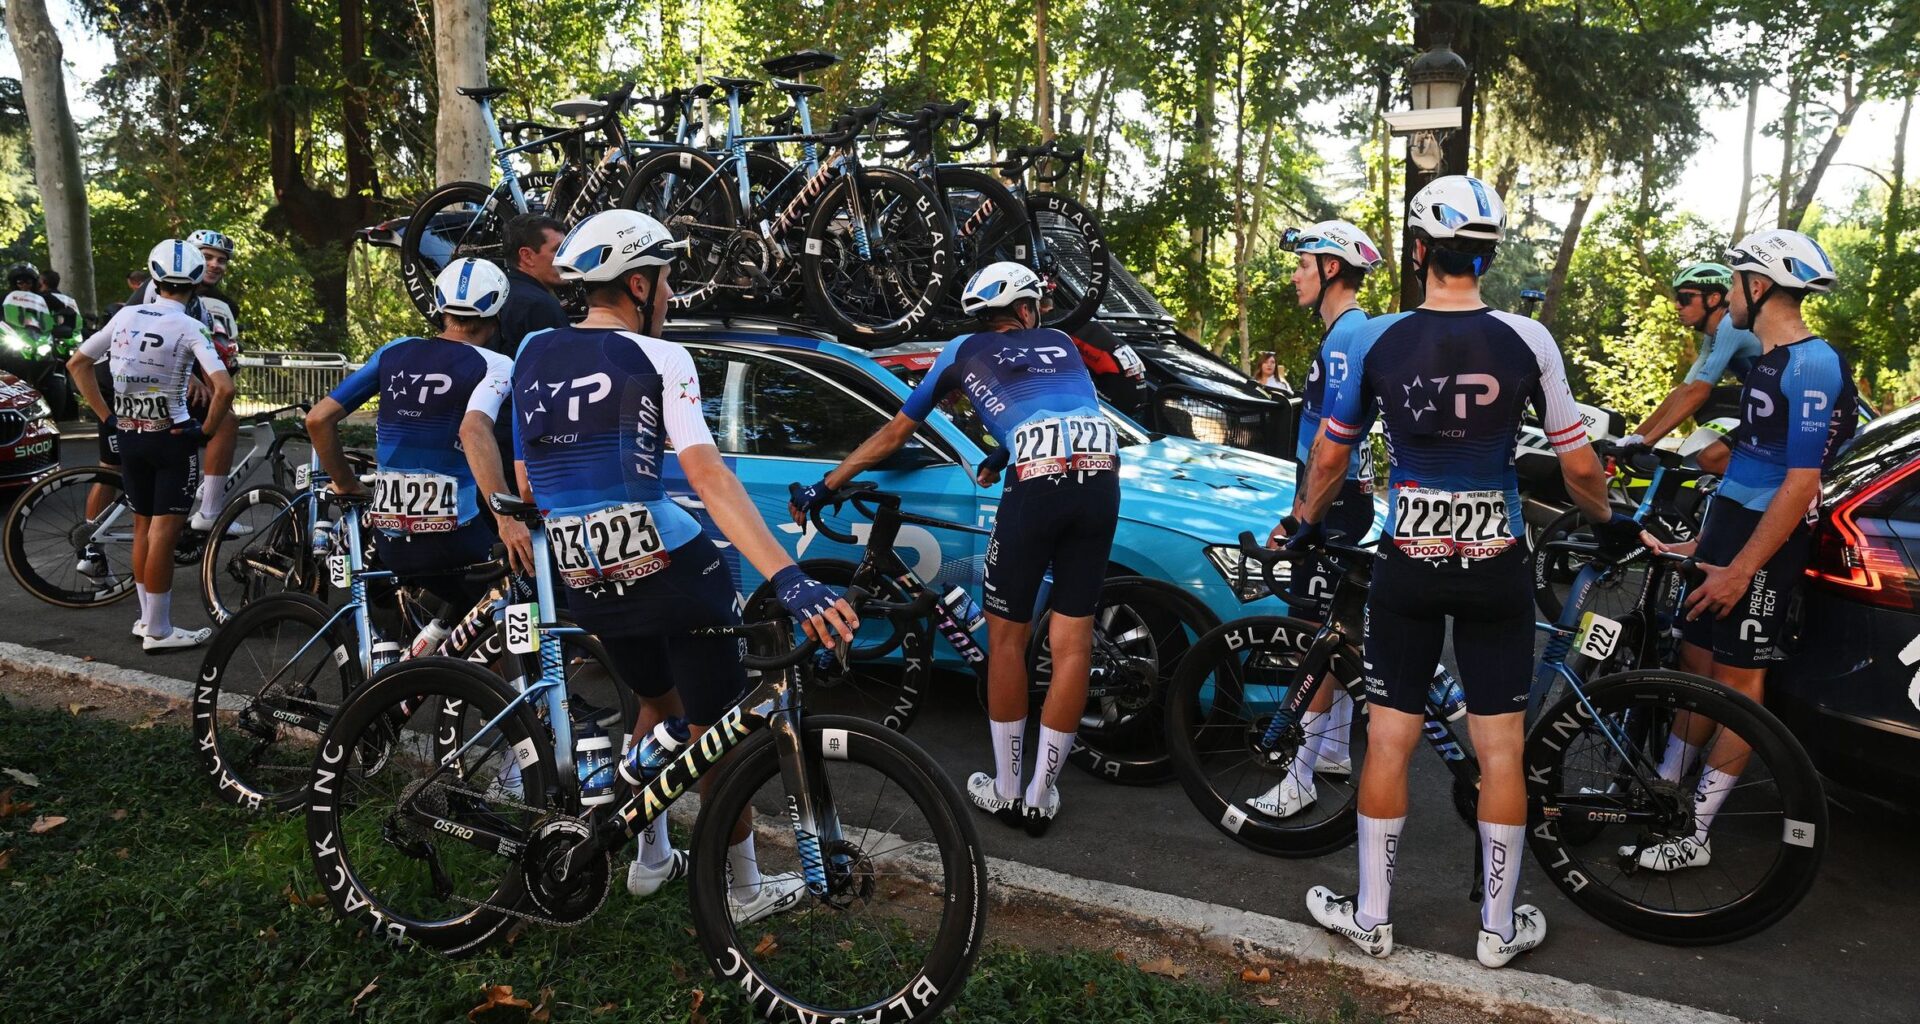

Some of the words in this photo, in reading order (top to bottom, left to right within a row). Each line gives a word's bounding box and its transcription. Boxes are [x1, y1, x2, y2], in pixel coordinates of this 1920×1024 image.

[916, 195, 945, 287] BLACK
[1049, 198, 1101, 252] BLACK
[1086, 261, 1103, 300] INC
[897, 295, 933, 334] INC
[134, 395, 170, 420] 228
[964, 372, 1006, 416] FACTOR
[635, 395, 661, 480] FACTOR
[1016, 423, 1060, 464] 227
[1069, 420, 1112, 453] 227
[1801, 420, 1826, 428] PREMIER
[224, 458, 251, 493] OTT
[406, 481, 456, 516] 224
[590, 509, 661, 566] 223
[1395, 495, 1451, 537] 222
[1455, 501, 1512, 542] 222
[331, 557, 344, 583] 224
[988, 538, 1000, 566] TECH
[1749, 569, 1768, 616] PREMIER
[1762, 590, 1777, 617] TECH
[508, 613, 529, 645] 223
[1224, 627, 1315, 652] BLAC
[1585, 623, 1616, 657] 222
[196, 665, 218, 720] INC
[884, 684, 918, 731] INC
[1289, 673, 1315, 712] FACTOR
[272, 709, 302, 724] OSTRO
[1541, 695, 1602, 752] INC
[199, 732, 264, 811] BLACK
[312, 738, 344, 812] INC
[619, 705, 751, 840] FACTOR
[1253, 800, 1288, 816] nimbl
[1587, 811, 1627, 823] OSTRO
[433, 818, 474, 840] OSTRO
[1331, 923, 1383, 945] SPECIALIZED
